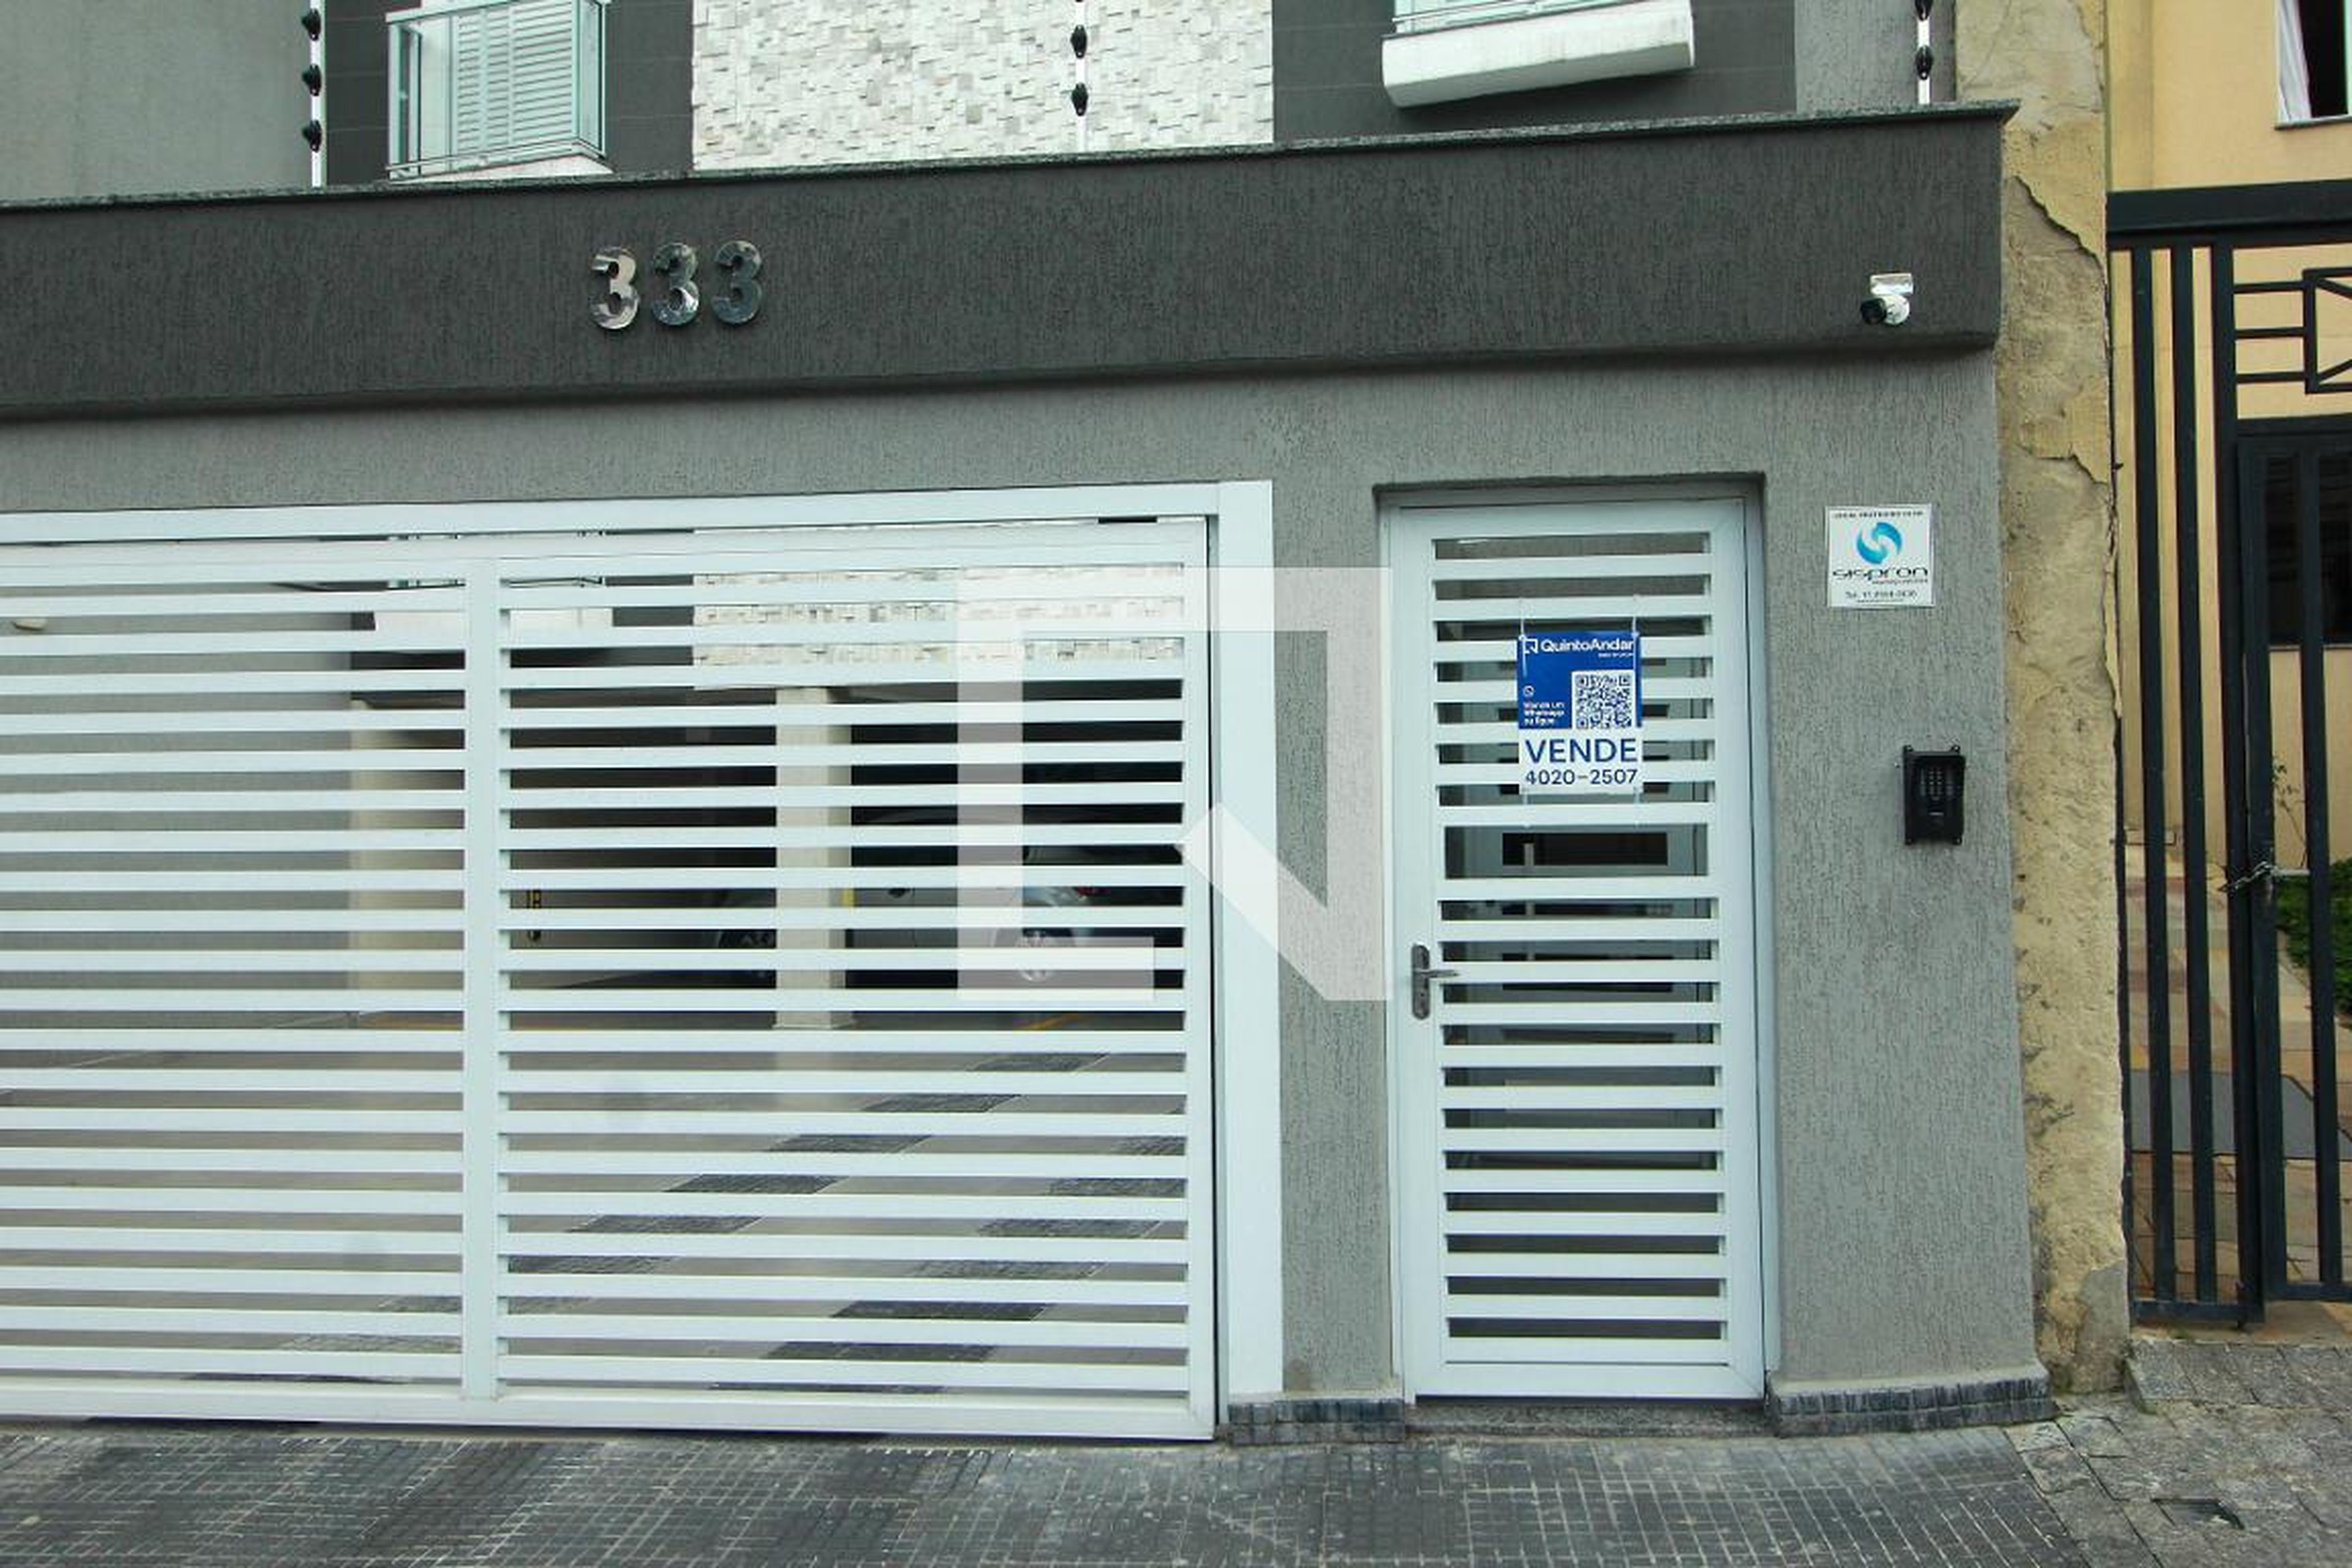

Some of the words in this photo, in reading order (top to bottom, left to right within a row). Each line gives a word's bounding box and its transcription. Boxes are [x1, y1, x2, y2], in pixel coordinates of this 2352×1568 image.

[589, 240, 763, 330] 333
[1540, 638, 1634, 652] QuintoAndar
[1525, 739, 1638, 763] VENDE
[1526, 769, 1638, 785] 4020-2507
